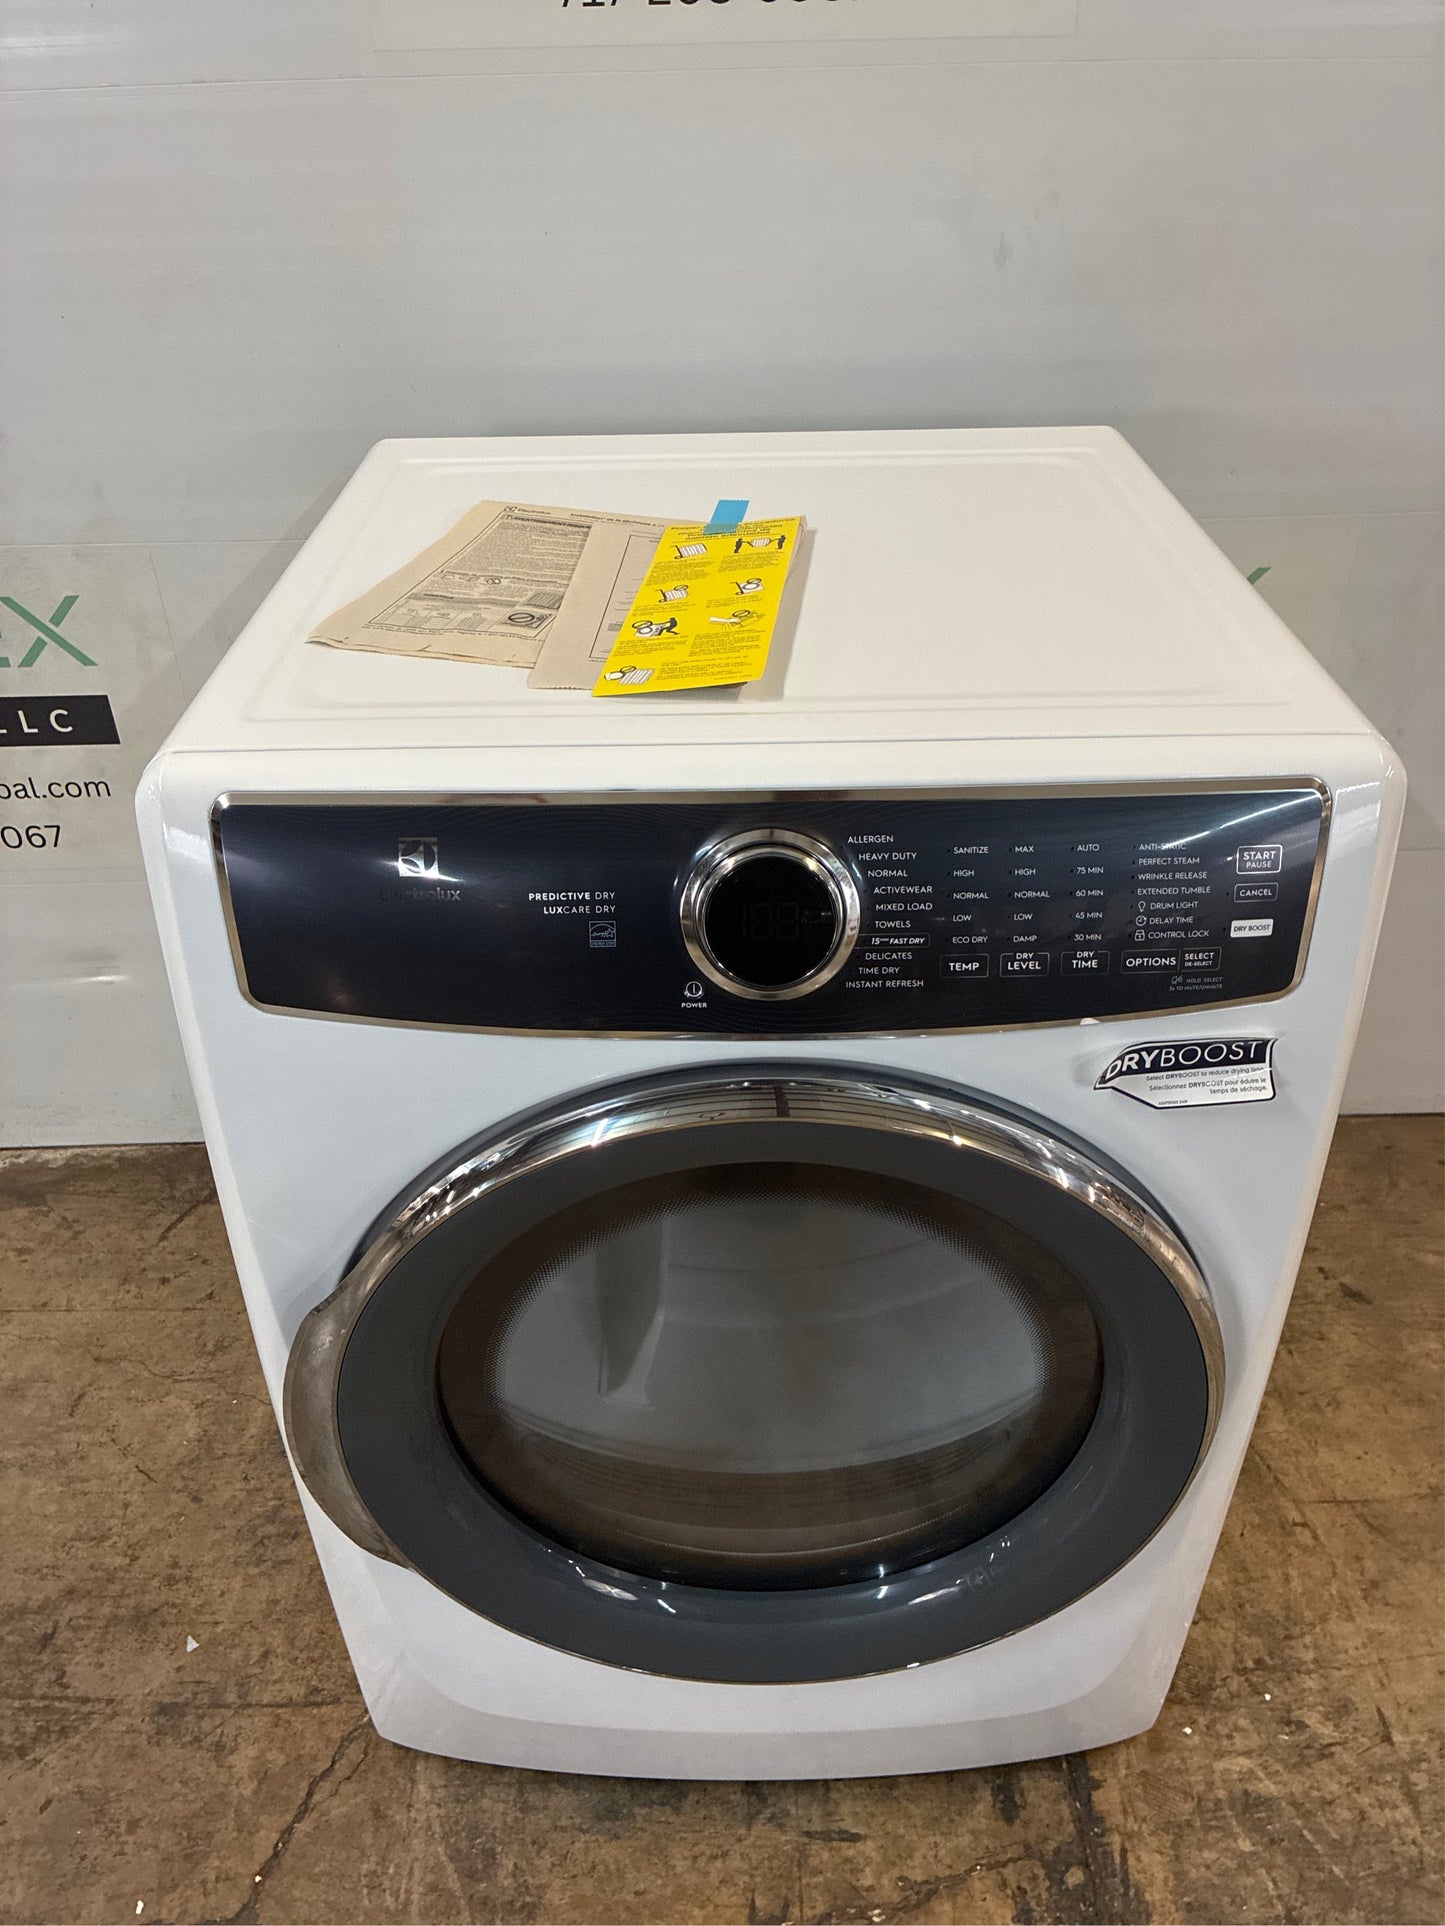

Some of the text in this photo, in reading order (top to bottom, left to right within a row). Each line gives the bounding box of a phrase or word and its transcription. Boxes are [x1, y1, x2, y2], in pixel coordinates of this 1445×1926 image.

[847, 835, 894, 844] ALLERGEN
[953, 846, 989, 854] SANITIZE
[1076, 844, 1100, 852] AUTO
[858, 852, 917, 861] HEAVY DUTY
[1243, 851, 1277, 861] START
[1138, 857, 1200, 866] PERFECT STEAM
[1246, 860, 1272, 869] PAUSE
[867, 869, 908, 877] NORMAL
[953, 869, 975, 877] HIGH
[1014, 868, 1036, 876] HIGH
[1076, 866, 1104, 875] 75 MIN
[1138, 871, 1208, 881] WRINKLE RELEASE
[873, 886, 933, 895] ACTIVEWEAR
[1014, 891, 1050, 899] NORMAL
[1075, 889, 1104, 897] 60 MIN
[1137, 886, 1211, 896] EXTENDED TUMBLE
[1239, 889, 1273, 897] CANCEL
[528, 891, 616, 901] PREDICTIVE DRY
[953, 892, 989, 900] NORMAL
[543, 905, 616, 915] LUXCARE DRY
[875, 902, 933, 911] MIXED LOAD
[1150, 901, 1199, 910] DRUM LIGHT
[952, 914, 972, 922] LOW
[1014, 913, 1033, 921] LOW
[1075, 911, 1103, 919] 45 MIN
[874, 920, 911, 929] TOWELS
[1149, 916, 1194, 925] DELAY TIME
[1233, 923, 1271, 932] DRY BOOST
[1013, 935, 1037, 943] DAMP
[1074, 933, 1102, 942] 30 MIN
[1147, 930, 1210, 939] CONTROL LOCK
[889, 937, 908, 945] FAST
[908, 937, 926, 945] DRY
[952, 936, 988, 944] ECO DRY
[865, 952, 913, 960] DELICATES
[1184, 952, 1215, 961] SELECT
[949, 962, 980, 971] TEMP
[1007, 961, 1041, 970] LEVEL
[1071, 960, 1098, 969] TIME
[1125, 957, 1176, 967] OPTIONS
[858, 966, 900, 975] TIME DRY
[845, 980, 924, 989] INSTANT REFRESH
[1105, 1040, 1263, 1081] DRYBOOST
[1146, 1074, 1164, 1082] Select
[1165, 1071, 1201, 1080] DRYBOOST
[1208, 1068, 1230, 1077] reduce
[1230, 1066, 1250, 1076] drying
[1224, 1078, 1240, 1087] pour
[1210, 1086, 1229, 1095] temps
